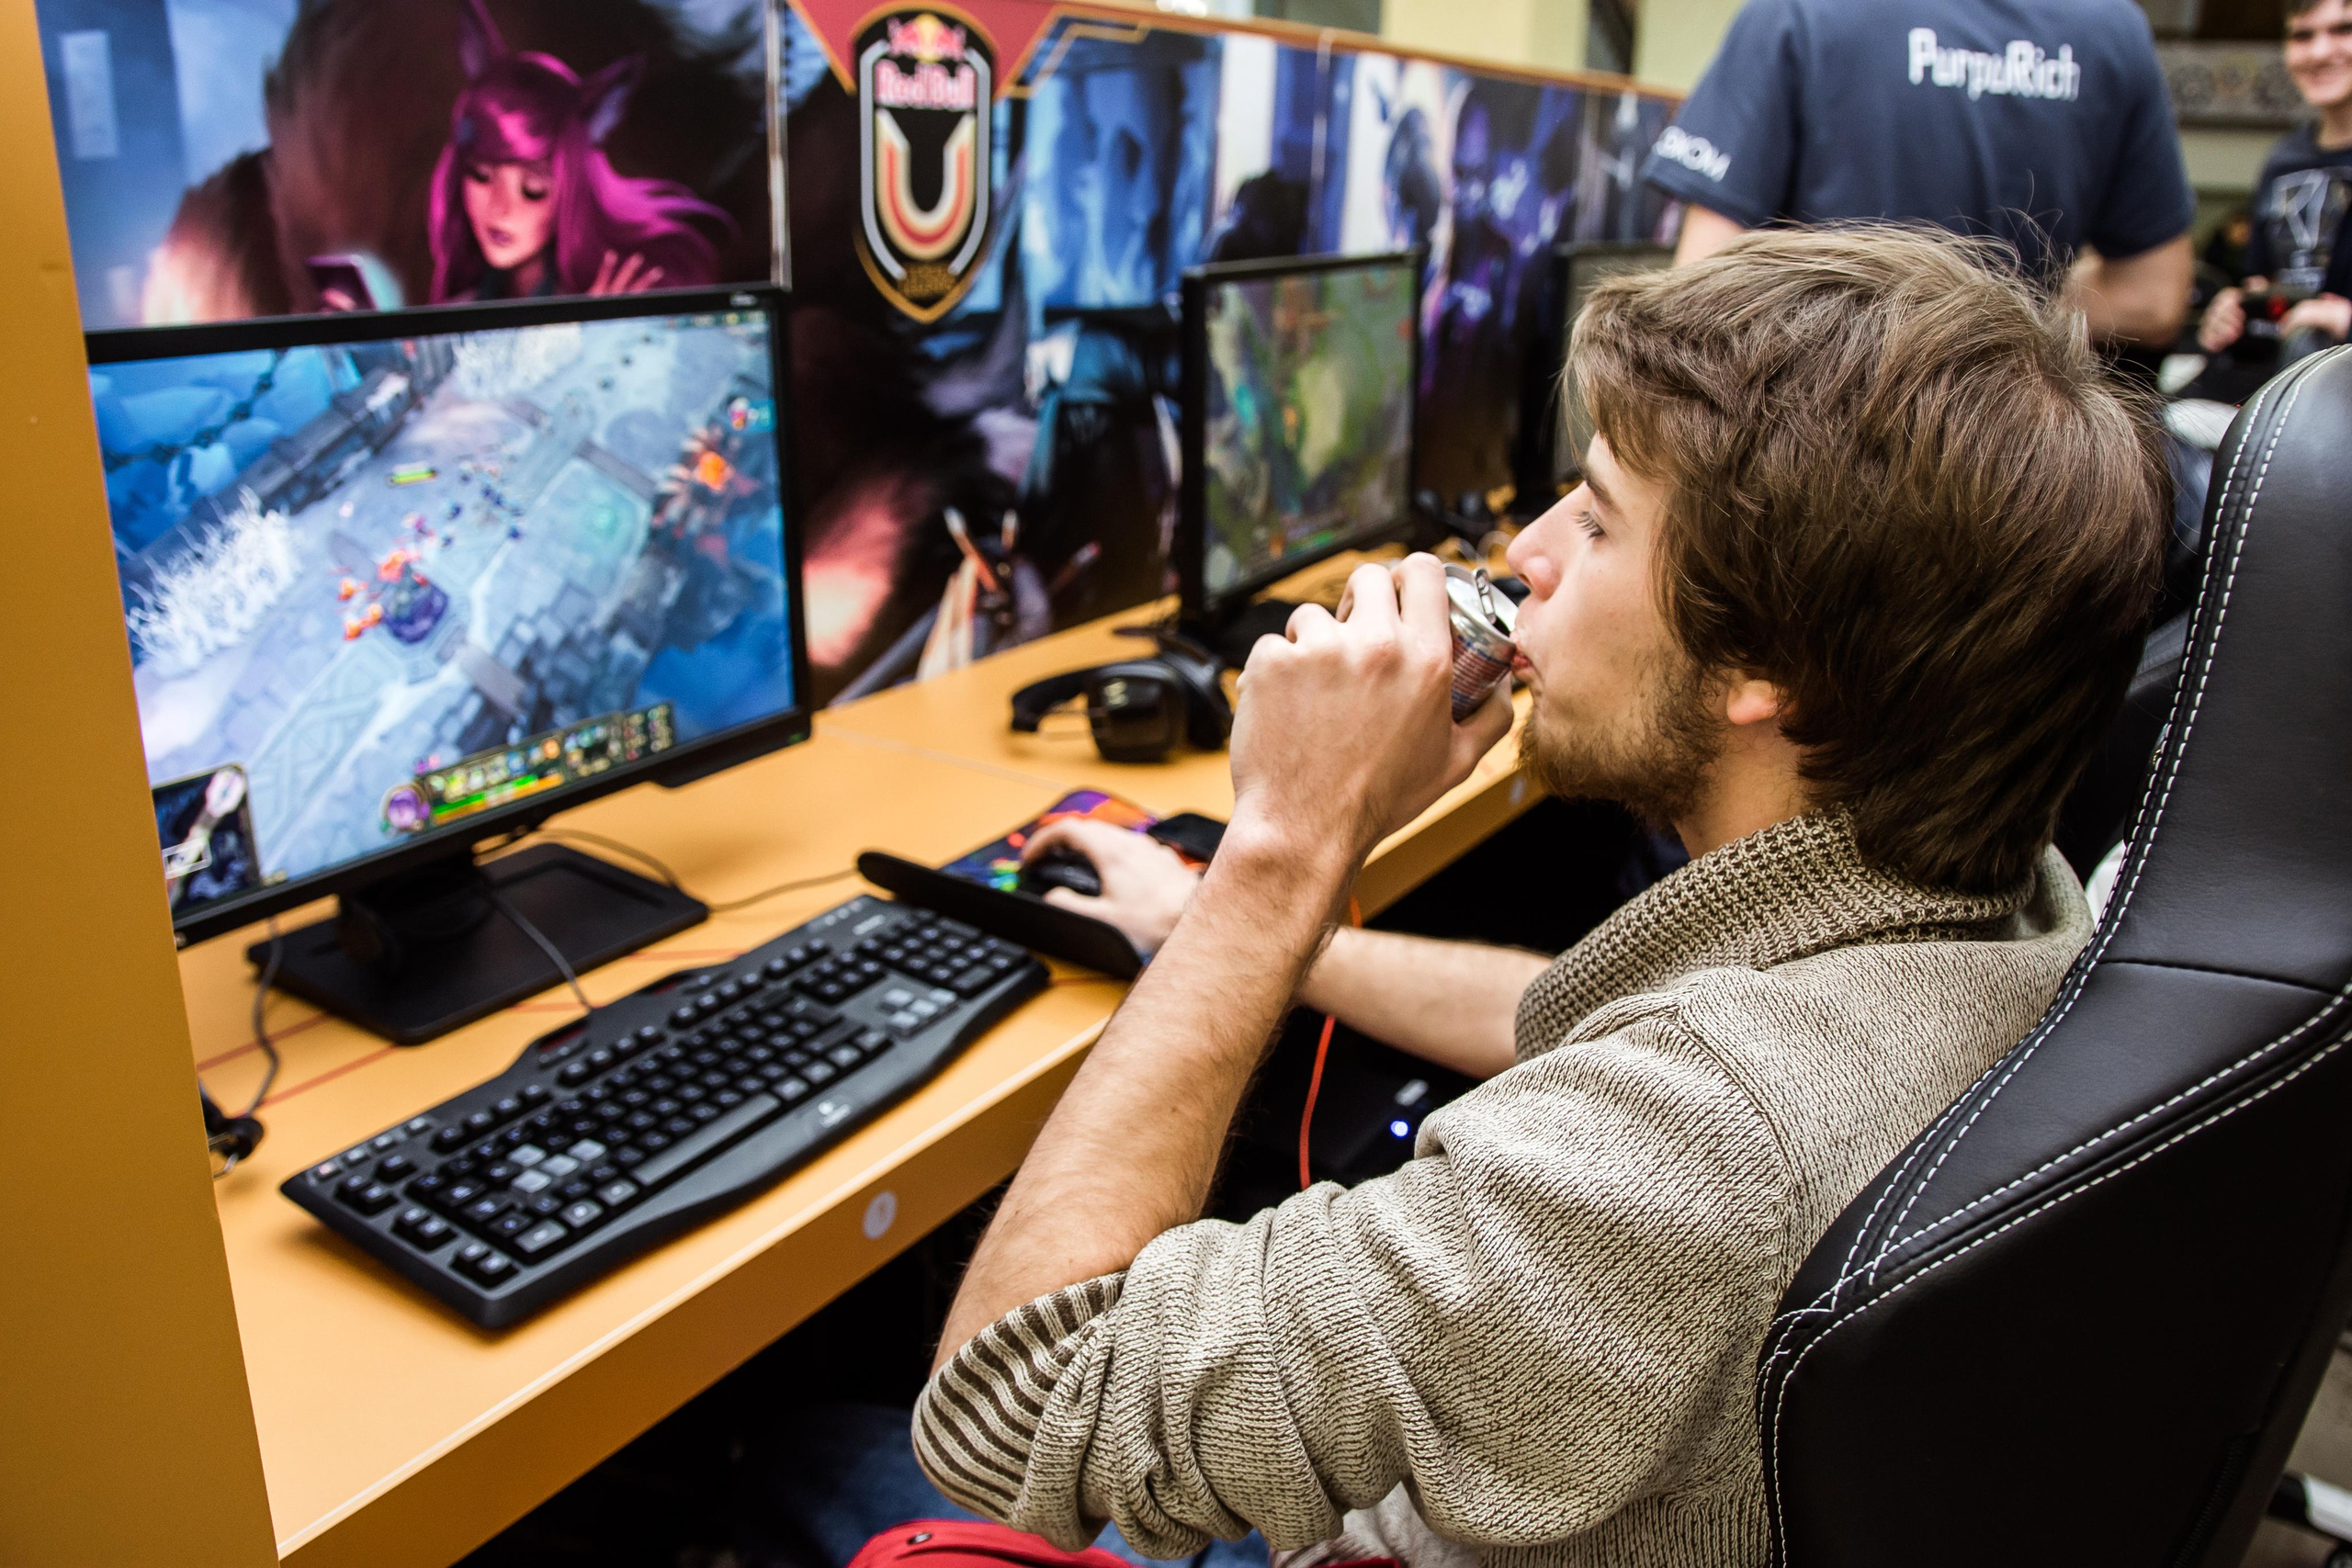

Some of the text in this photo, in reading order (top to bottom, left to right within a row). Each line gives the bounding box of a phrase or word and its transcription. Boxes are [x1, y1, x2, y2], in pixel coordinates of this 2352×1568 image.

[875, 59, 977, 110] Red Bull
[1908, 28, 2081, 102] PurpuRich
